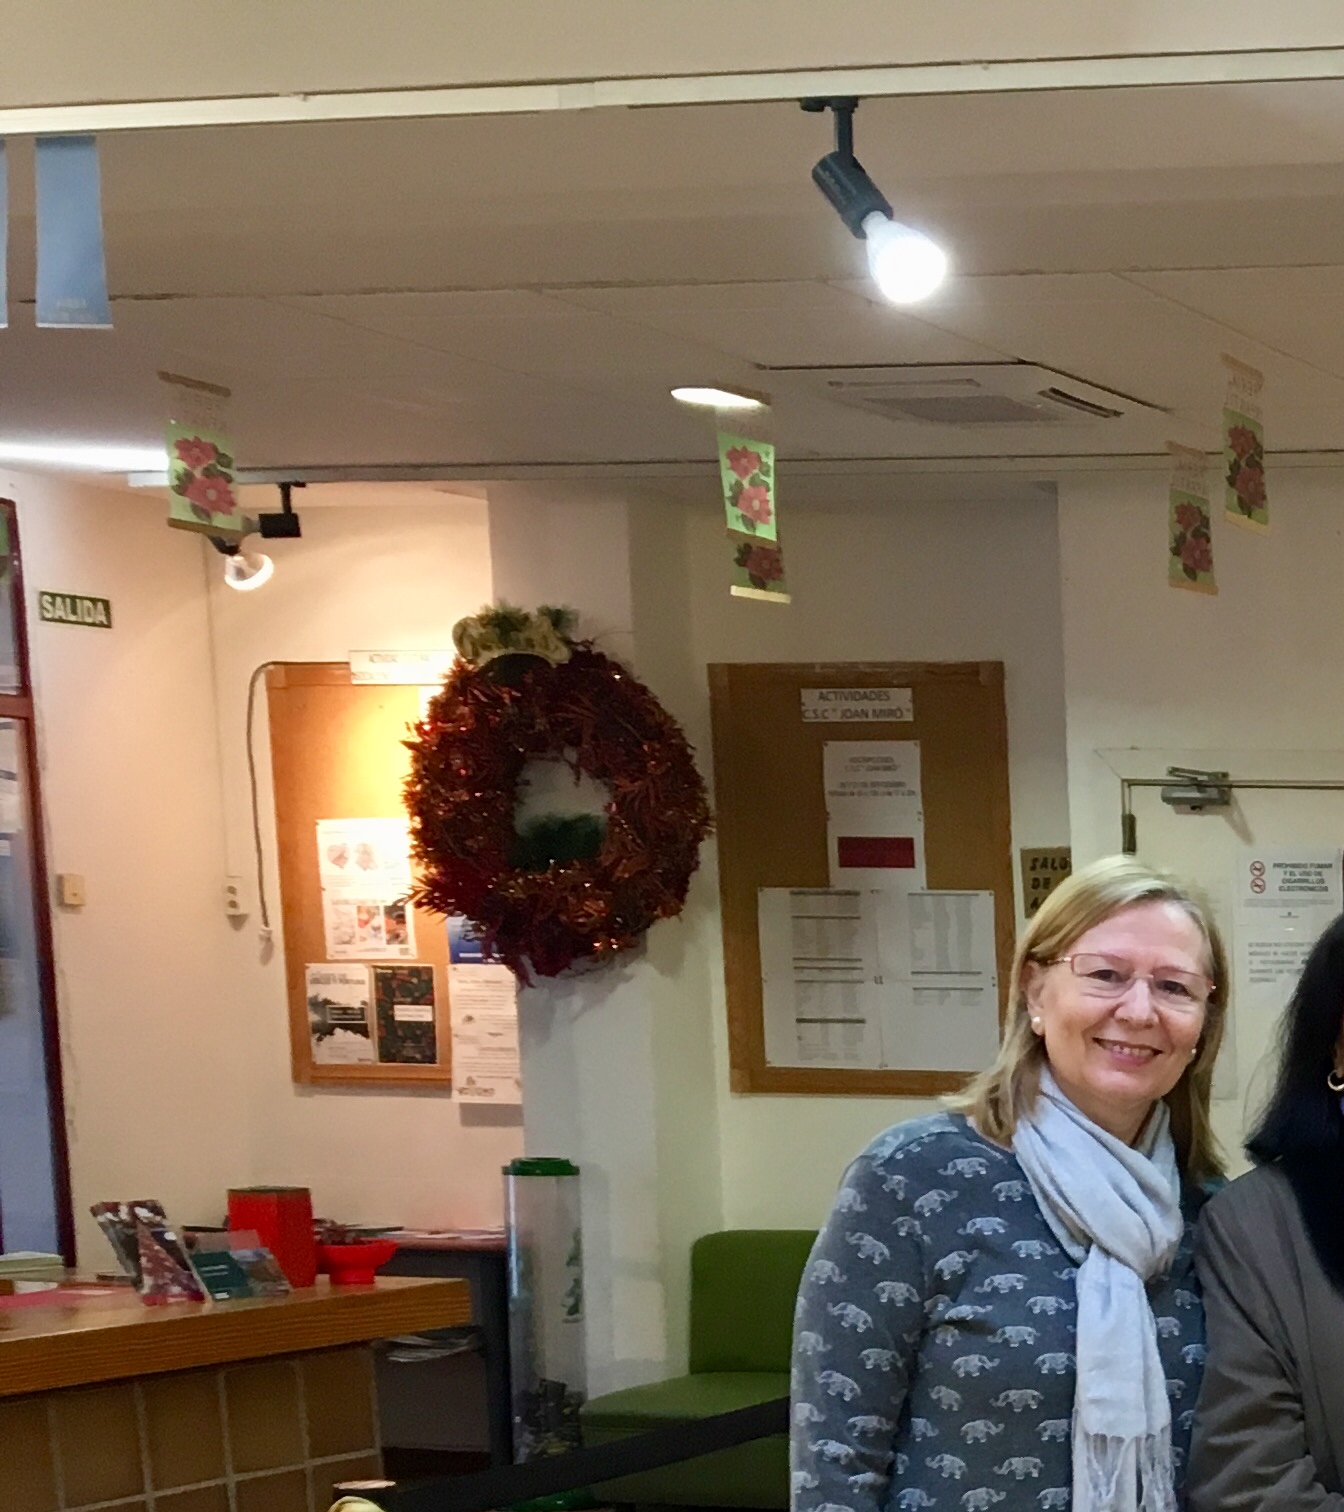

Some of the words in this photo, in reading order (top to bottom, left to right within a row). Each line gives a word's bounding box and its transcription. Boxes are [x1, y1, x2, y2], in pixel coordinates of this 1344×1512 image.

[41, 594, 108, 625] SALIDA
[818, 690, 890, 702] ACTIVIDADES
[840, 708, 869, 720] JOAN
[1031, 877, 1051, 890] DE
